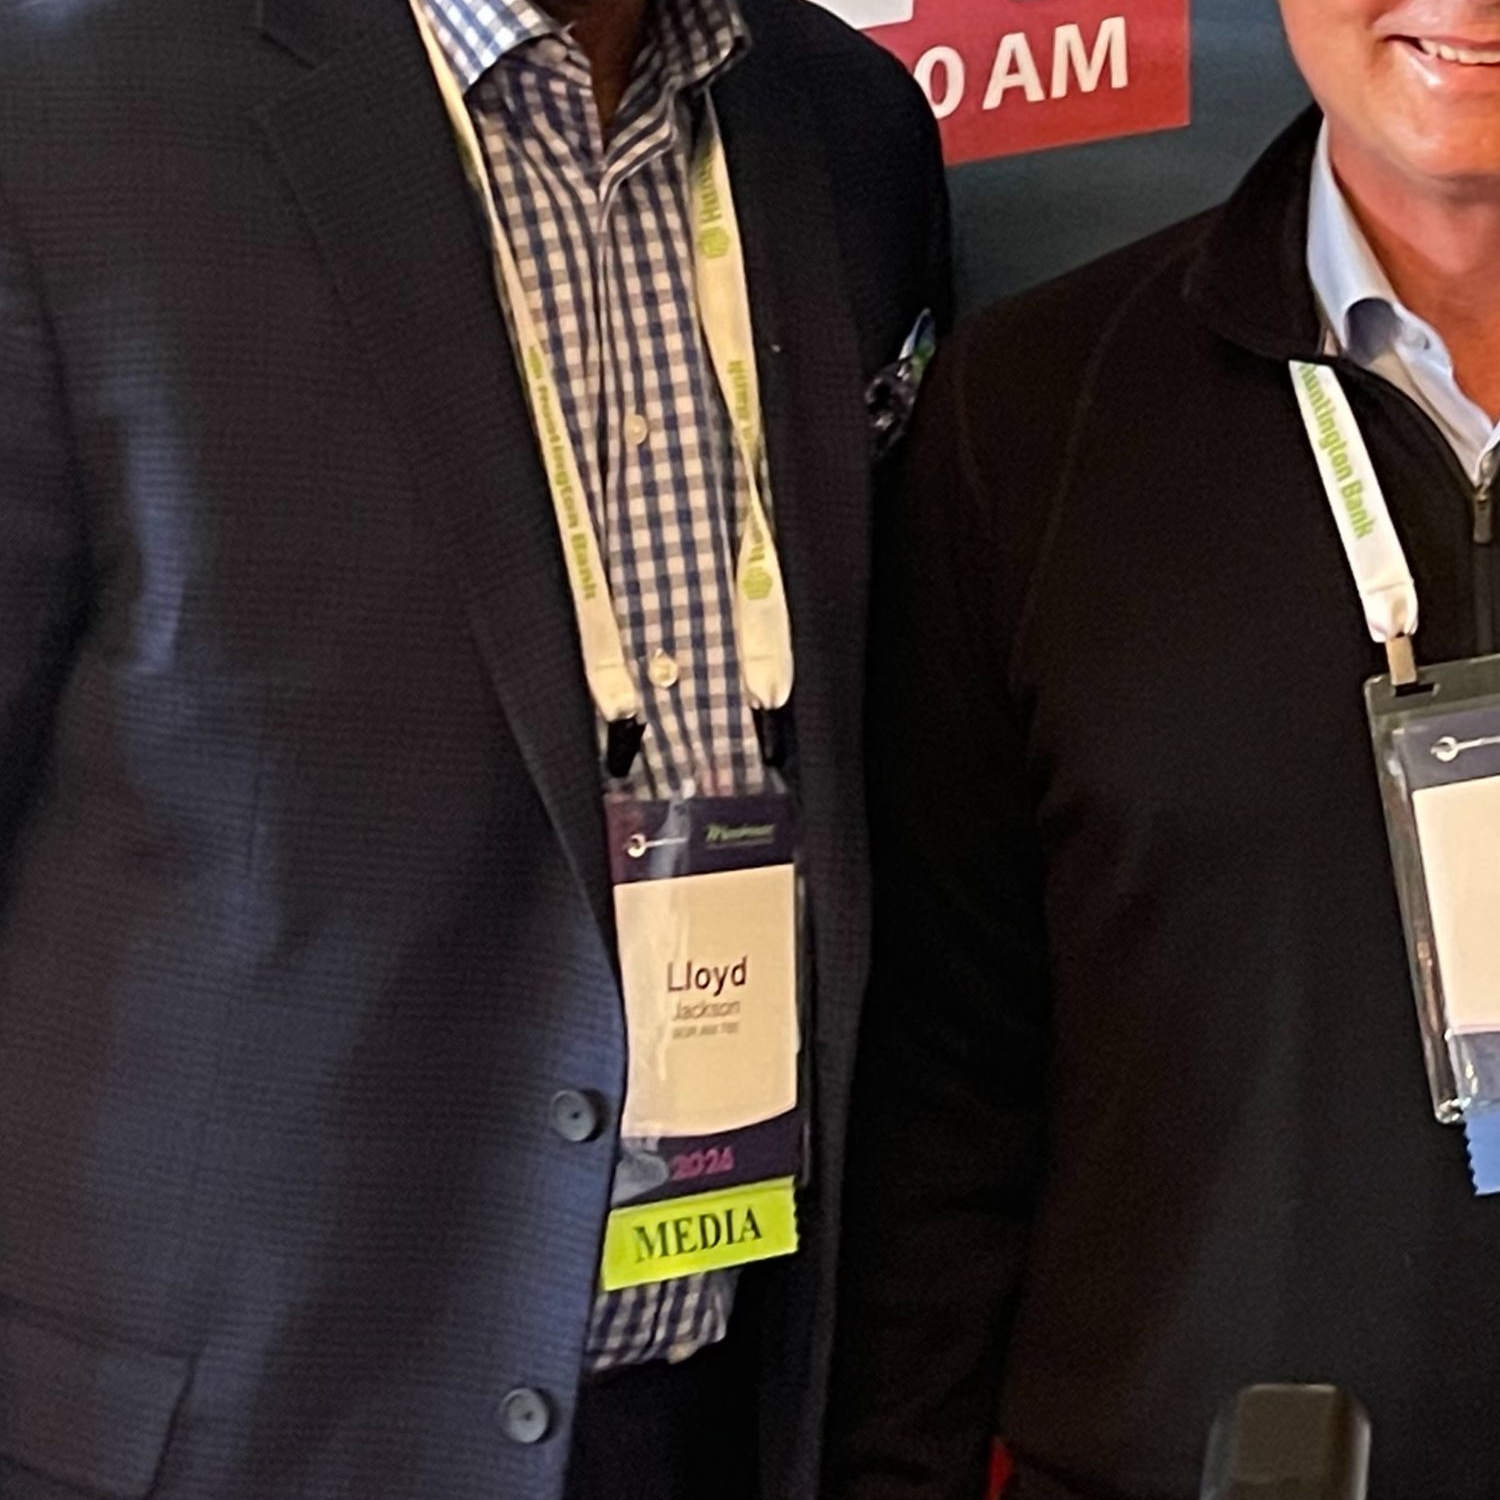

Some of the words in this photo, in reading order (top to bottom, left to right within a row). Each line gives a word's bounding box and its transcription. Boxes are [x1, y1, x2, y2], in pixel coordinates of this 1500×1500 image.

[982, 16, 1128, 110] AM
[1341, 479, 1376, 539] Bank
[667, 954, 748, 997] Lloyd
[634, 1206, 762, 1263] MEDIA
